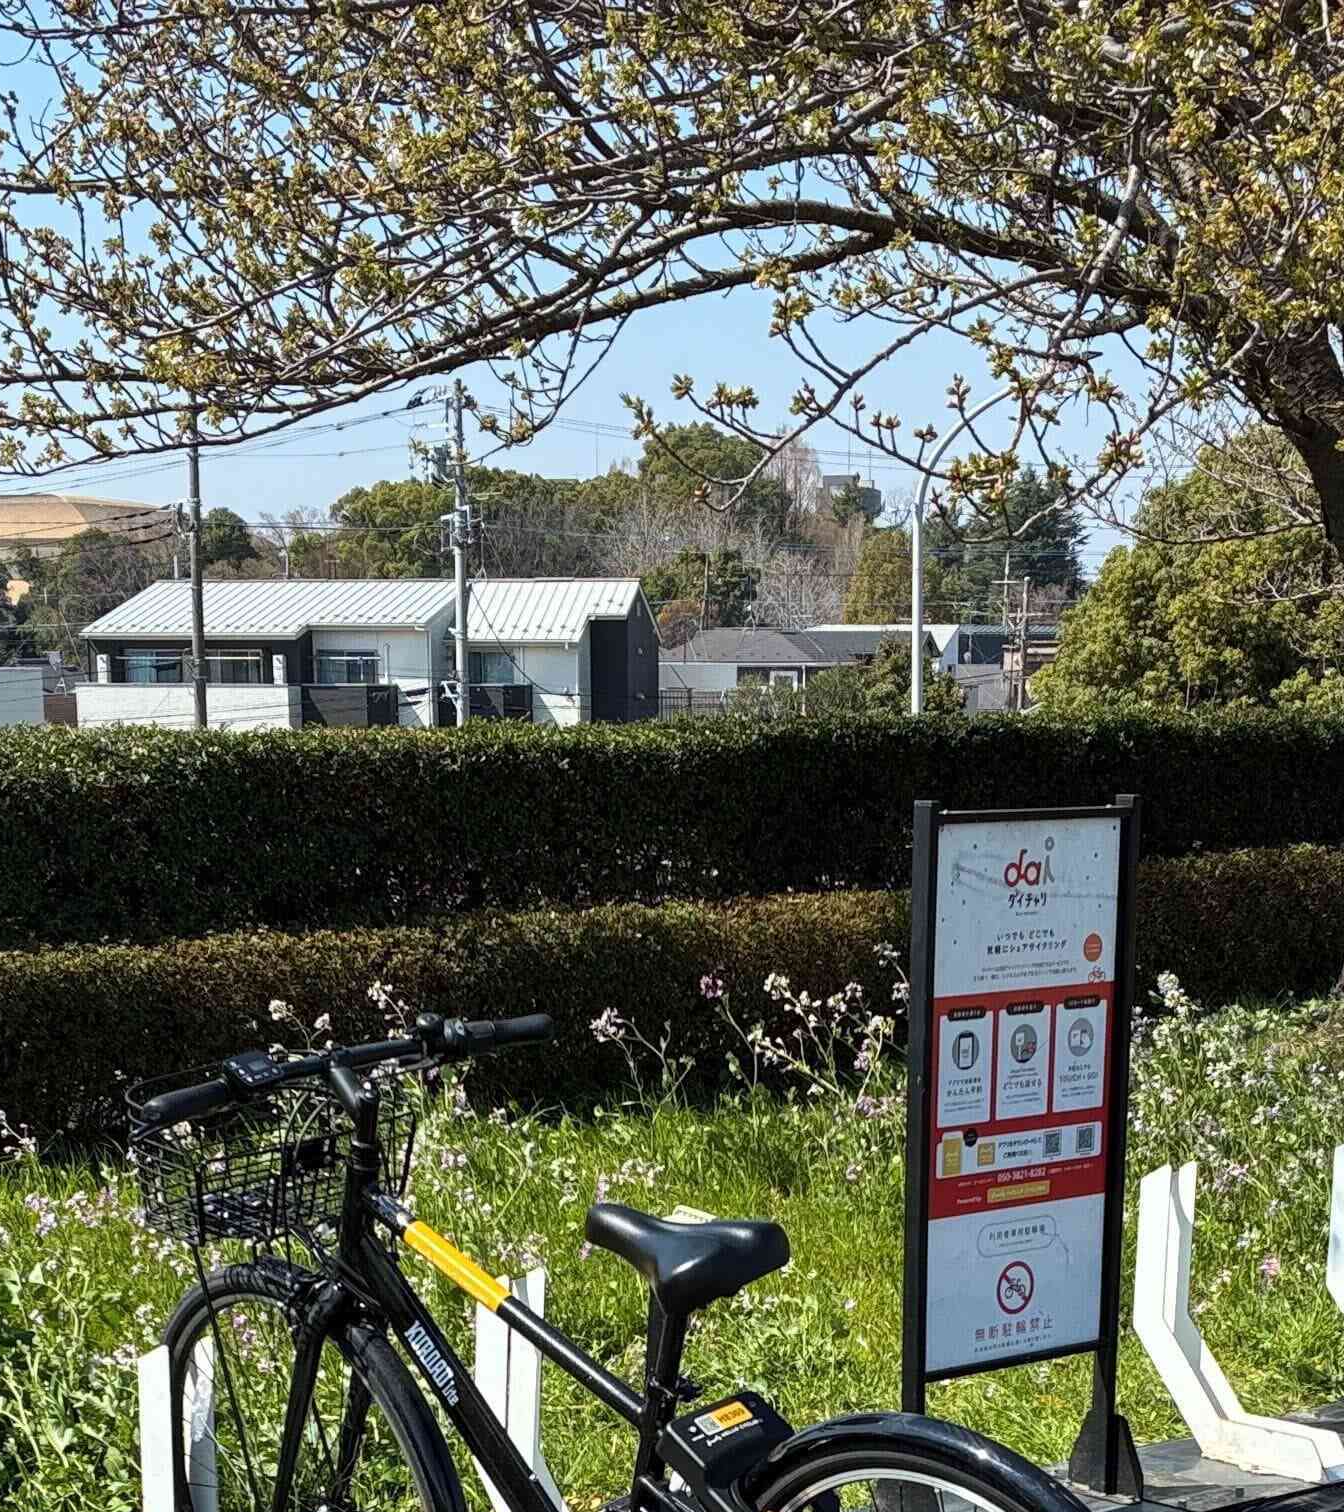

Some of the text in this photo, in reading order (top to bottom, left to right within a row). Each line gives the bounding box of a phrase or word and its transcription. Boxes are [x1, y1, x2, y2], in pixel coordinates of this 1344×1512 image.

[1004, 836, 1055, 887] dai
[1008, 889, 1047, 909] ダイチャリ
[1028, 928, 1055, 940] どこでも
